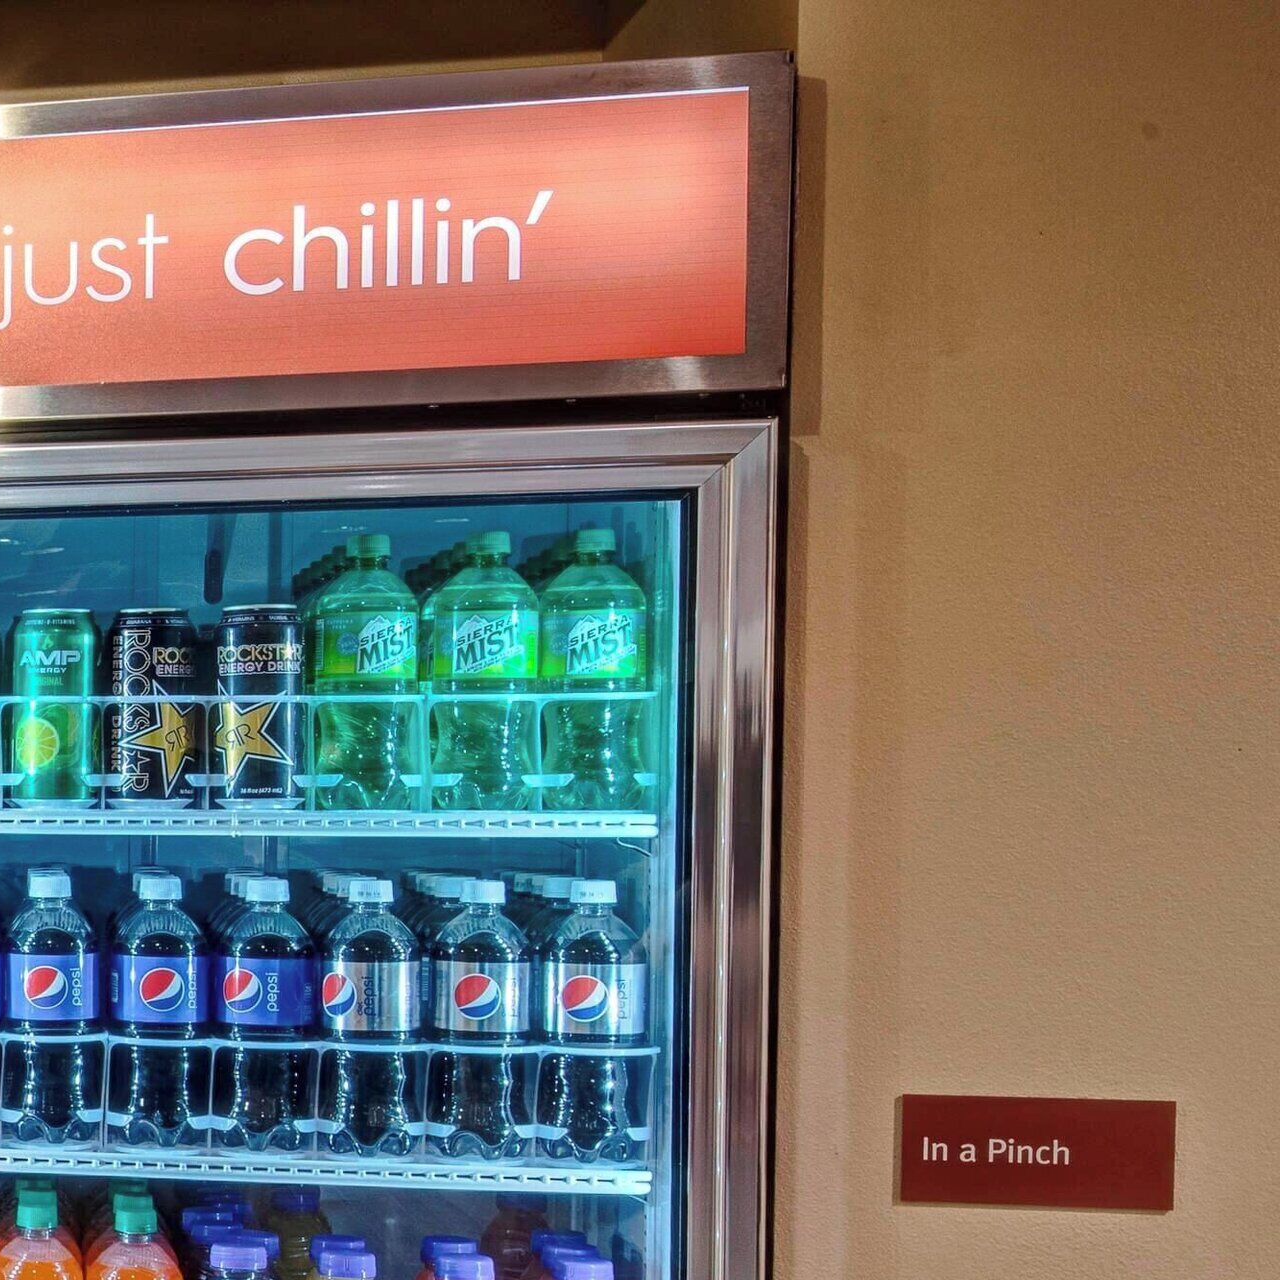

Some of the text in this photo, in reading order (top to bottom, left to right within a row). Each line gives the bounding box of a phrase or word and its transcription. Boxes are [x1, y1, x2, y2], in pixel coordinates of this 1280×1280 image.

[358, 625, 416, 673] MIST
[359, 615, 413, 648] SIERRA
[455, 615, 516, 648] SIERRA
[456, 625, 520, 673] MIST
[567, 614, 629, 649] SIERRA
[568, 622, 634, 673] MIST
[20, 650, 82, 666] AMP
[218, 643, 304, 663] ROCKSTAR
[219, 660, 301, 674] ENERGY DRINK
[71, 967, 82, 1007] pepsi
[187, 968, 197, 1009] pepsi
[266, 972, 279, 1013] pepsi
[364, 976, 376, 1017] pepsi
[922, 1136, 1071, 1166] In a Pinch
